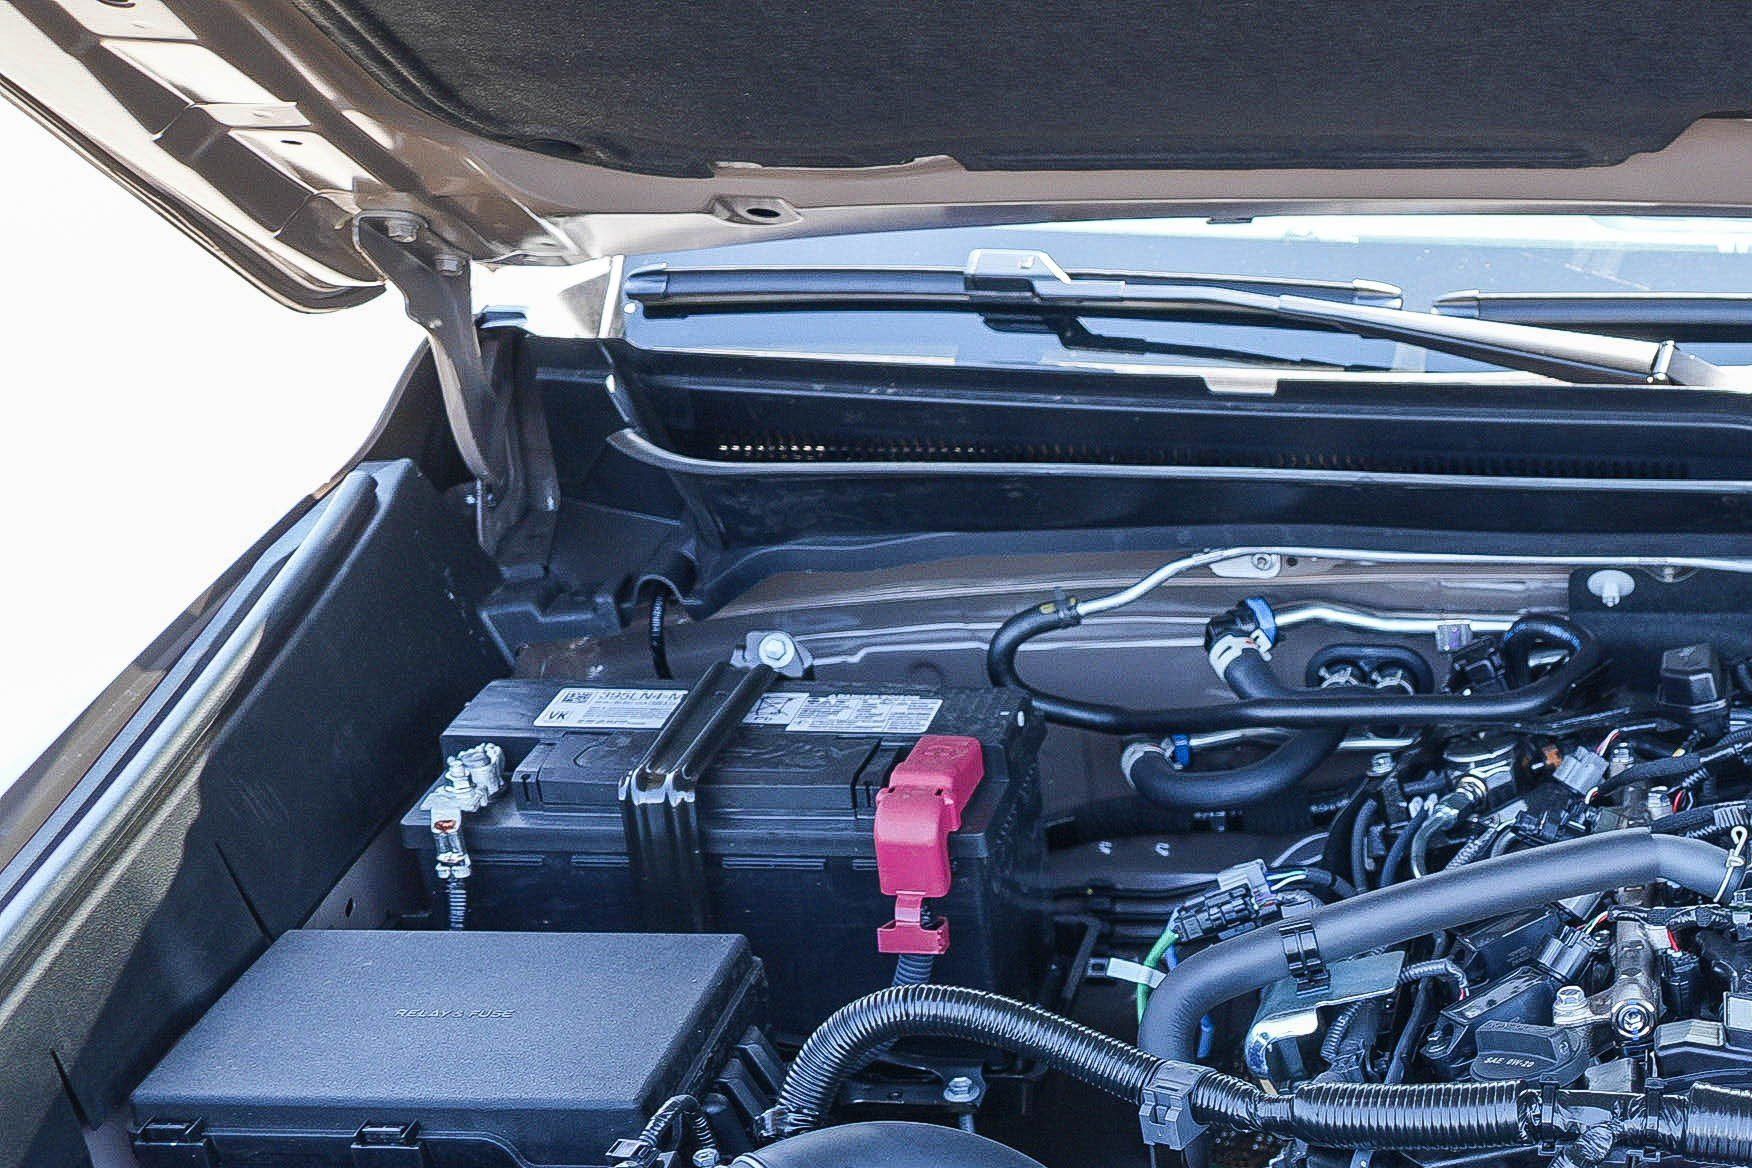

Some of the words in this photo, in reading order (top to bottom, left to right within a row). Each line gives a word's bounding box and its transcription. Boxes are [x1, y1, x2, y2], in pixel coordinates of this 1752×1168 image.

[394, 1008, 452, 1019] RELAY
[468, 1008, 516, 1019] FUSE
[1484, 1056, 1505, 1065] SAE
